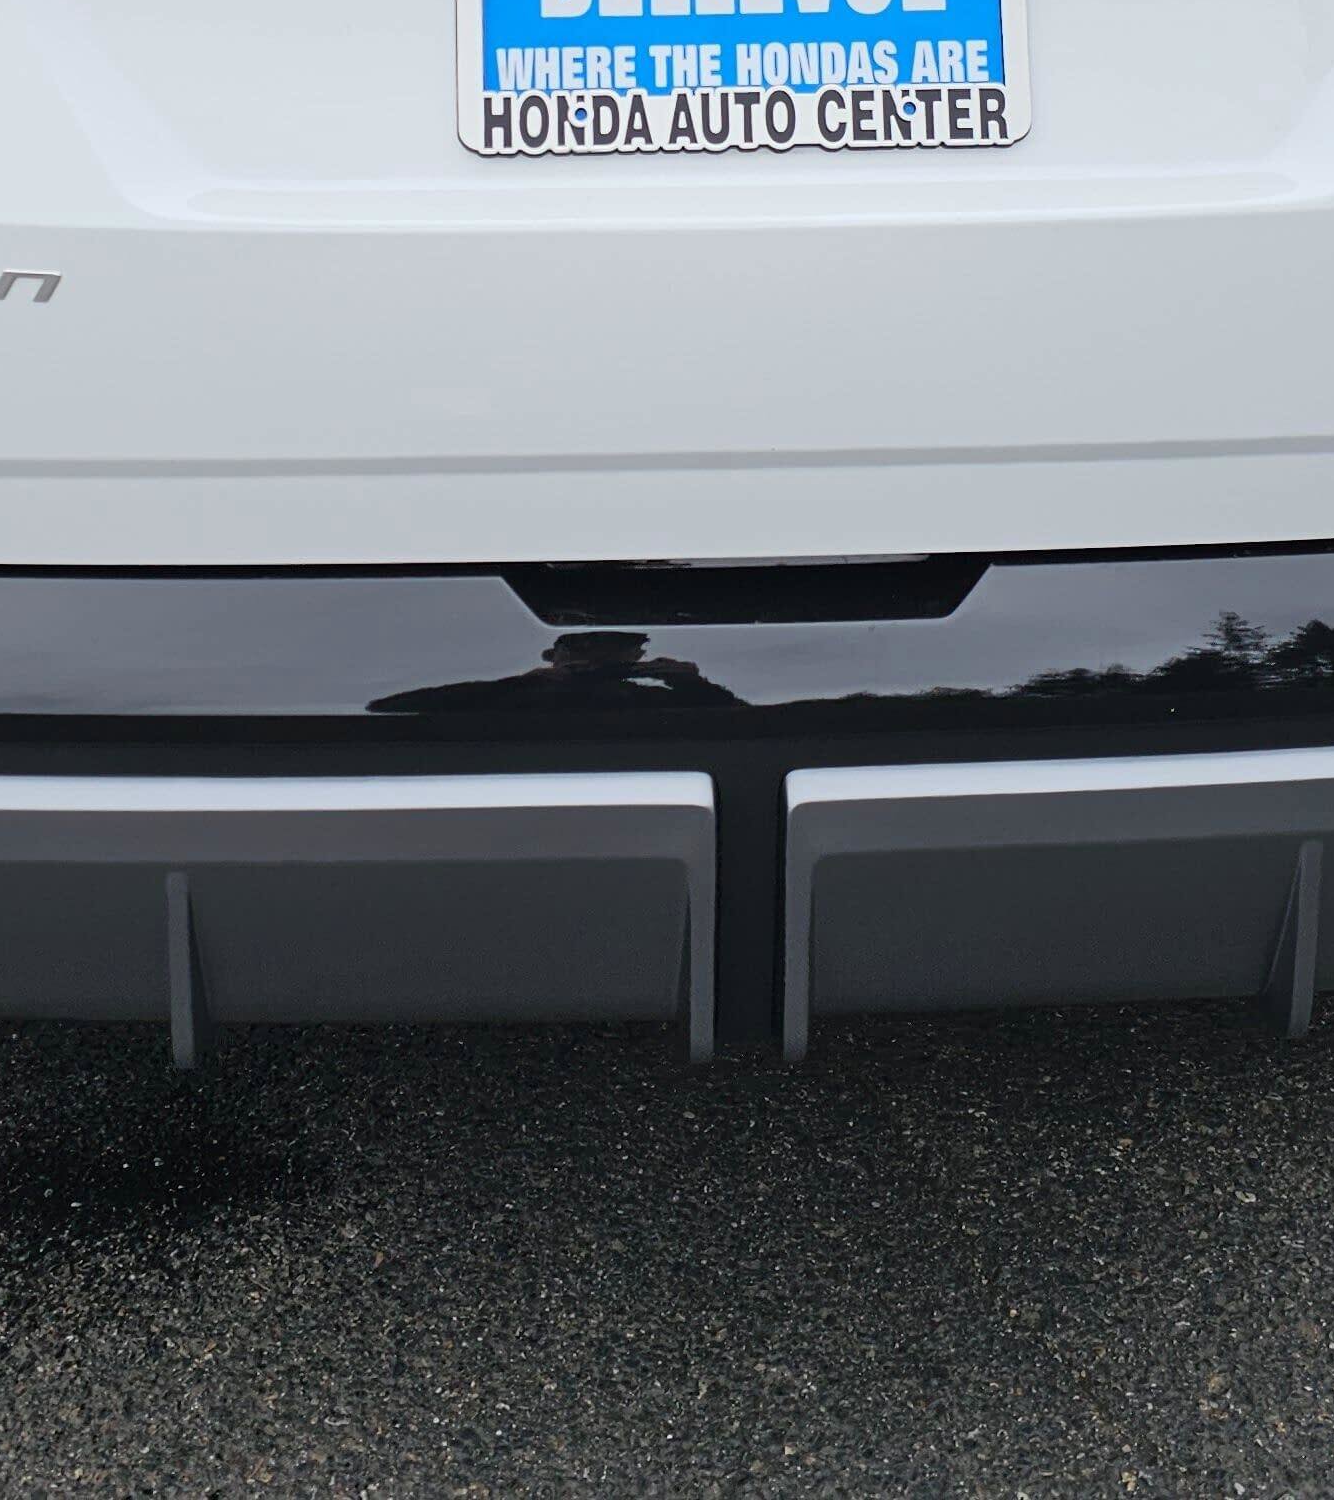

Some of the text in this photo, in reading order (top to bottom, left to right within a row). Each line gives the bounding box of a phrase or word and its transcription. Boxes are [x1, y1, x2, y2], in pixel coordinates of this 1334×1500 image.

[496, 40, 989, 92] WHERE THE HONDAS ARE
[483, 88, 1010, 149] HONDA AUTO CENTER
